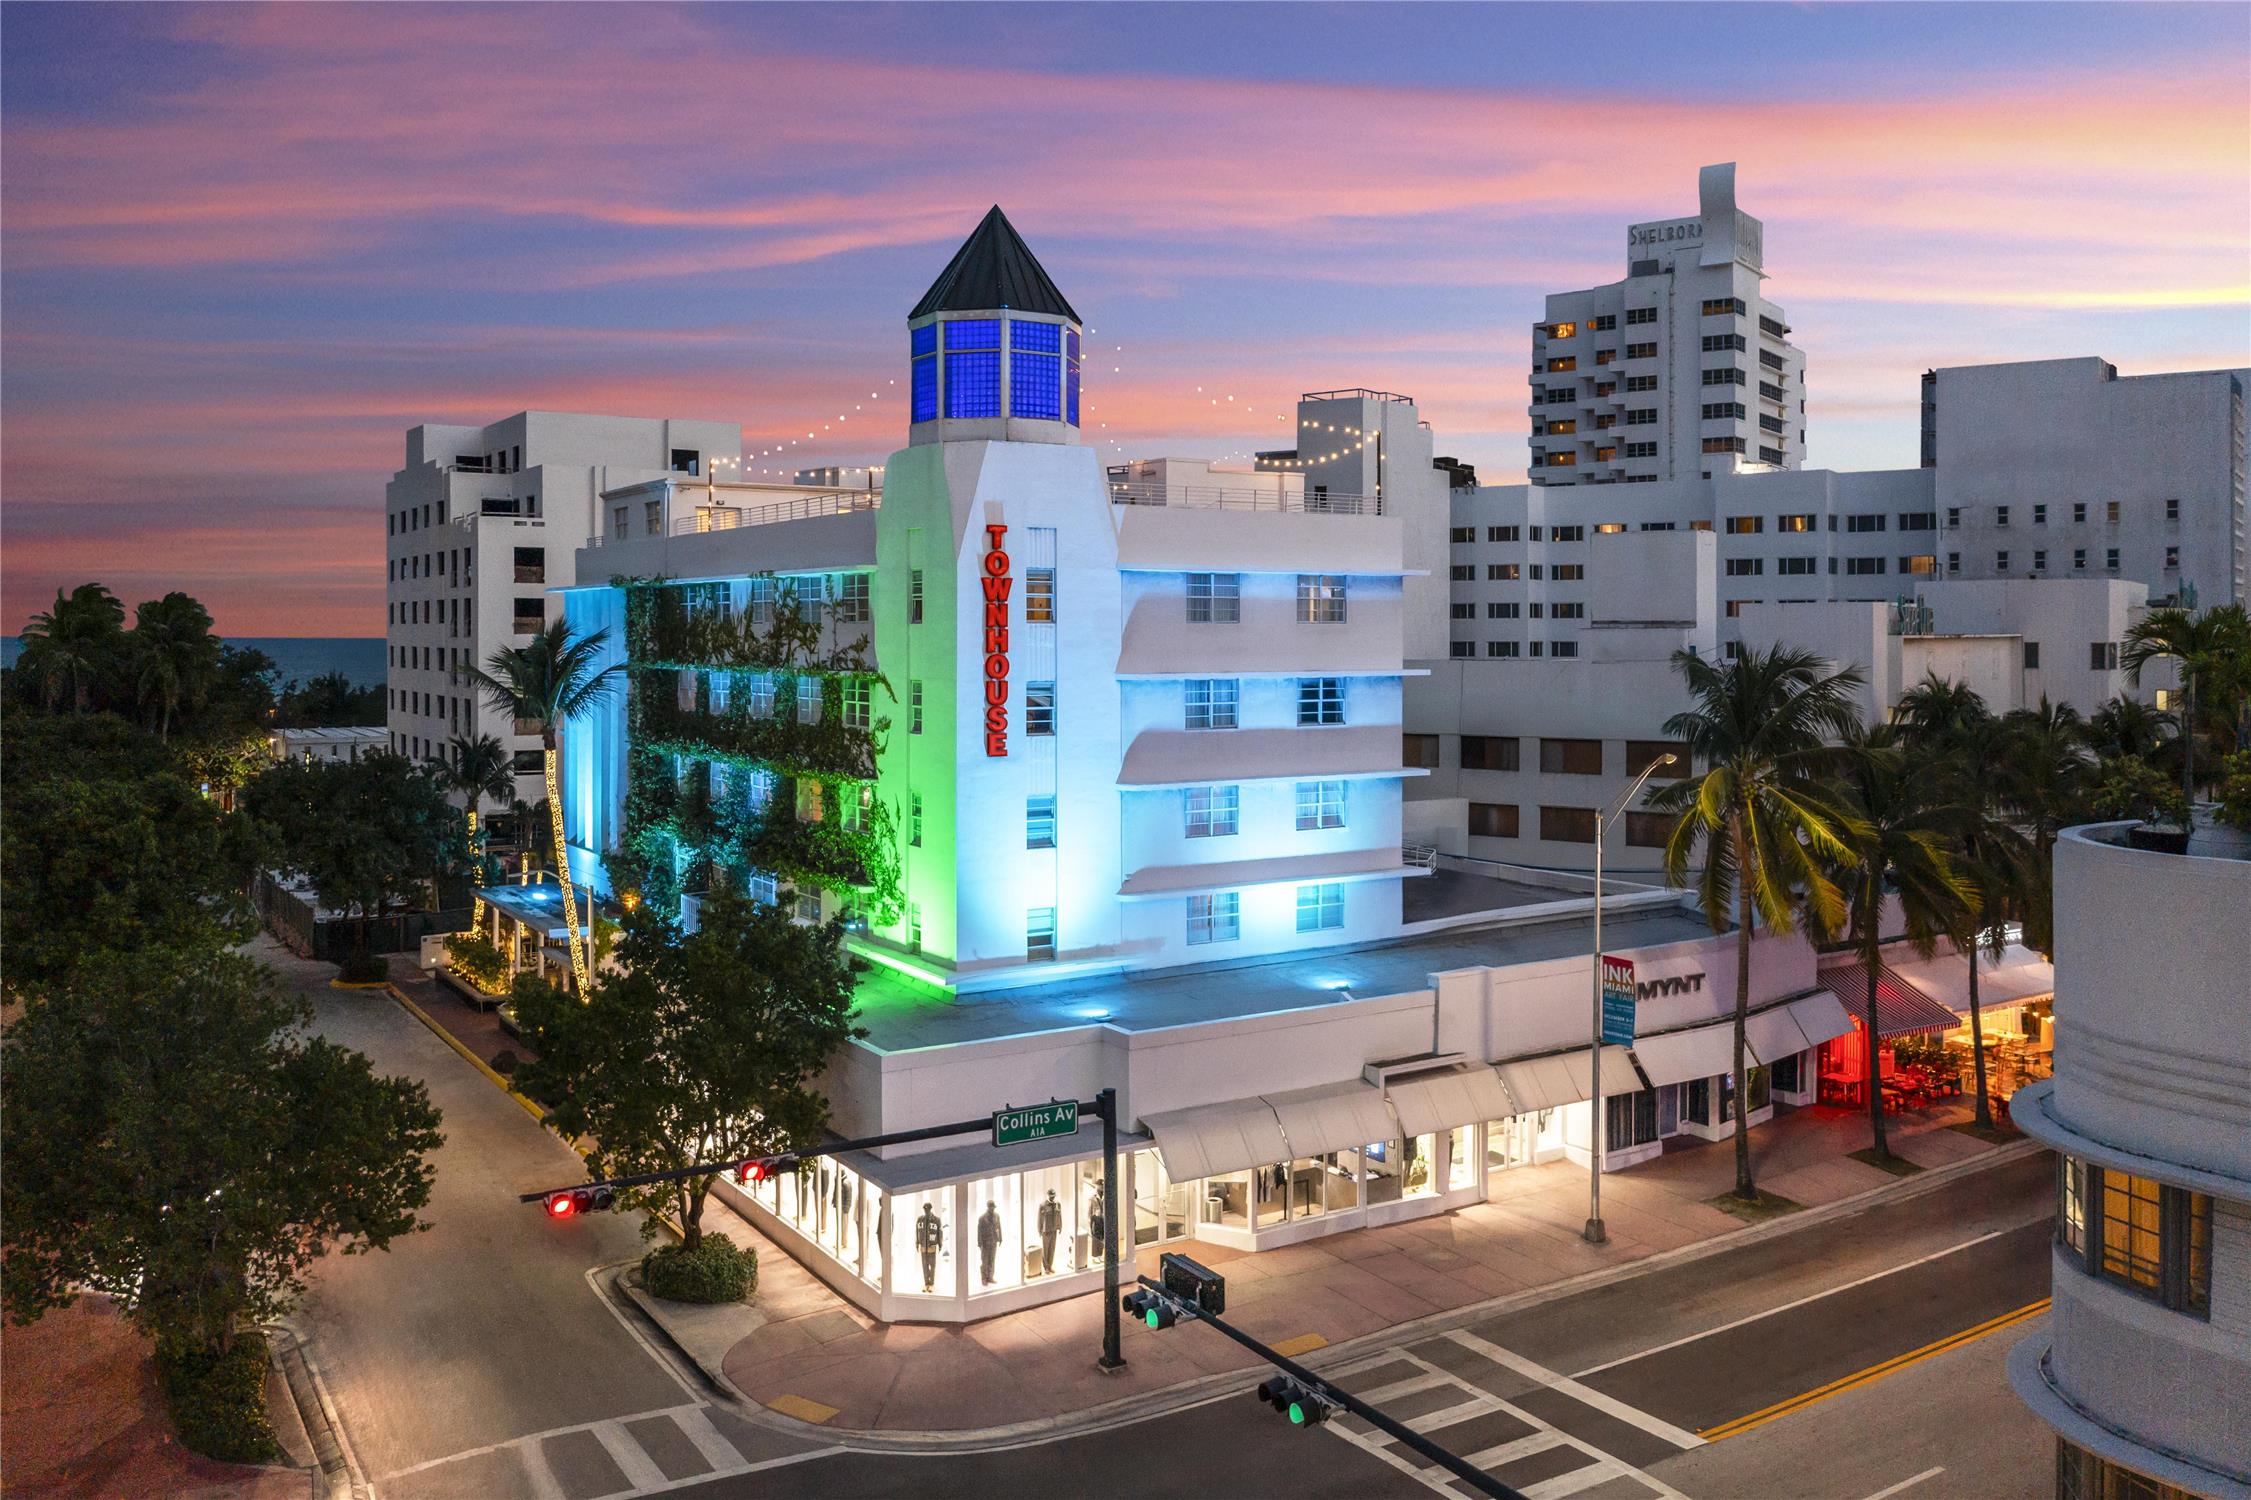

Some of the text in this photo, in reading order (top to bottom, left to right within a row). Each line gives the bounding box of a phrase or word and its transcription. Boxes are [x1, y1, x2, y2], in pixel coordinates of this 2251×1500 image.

[981, 524, 1013, 757] TOWNHOUSE
[1604, 964, 1633, 985] INK
[1604, 982, 1634, 995] MIAMI
[1637, 973, 1706, 1001] MYNT
[1000, 1107, 1074, 1131] Collins Av
